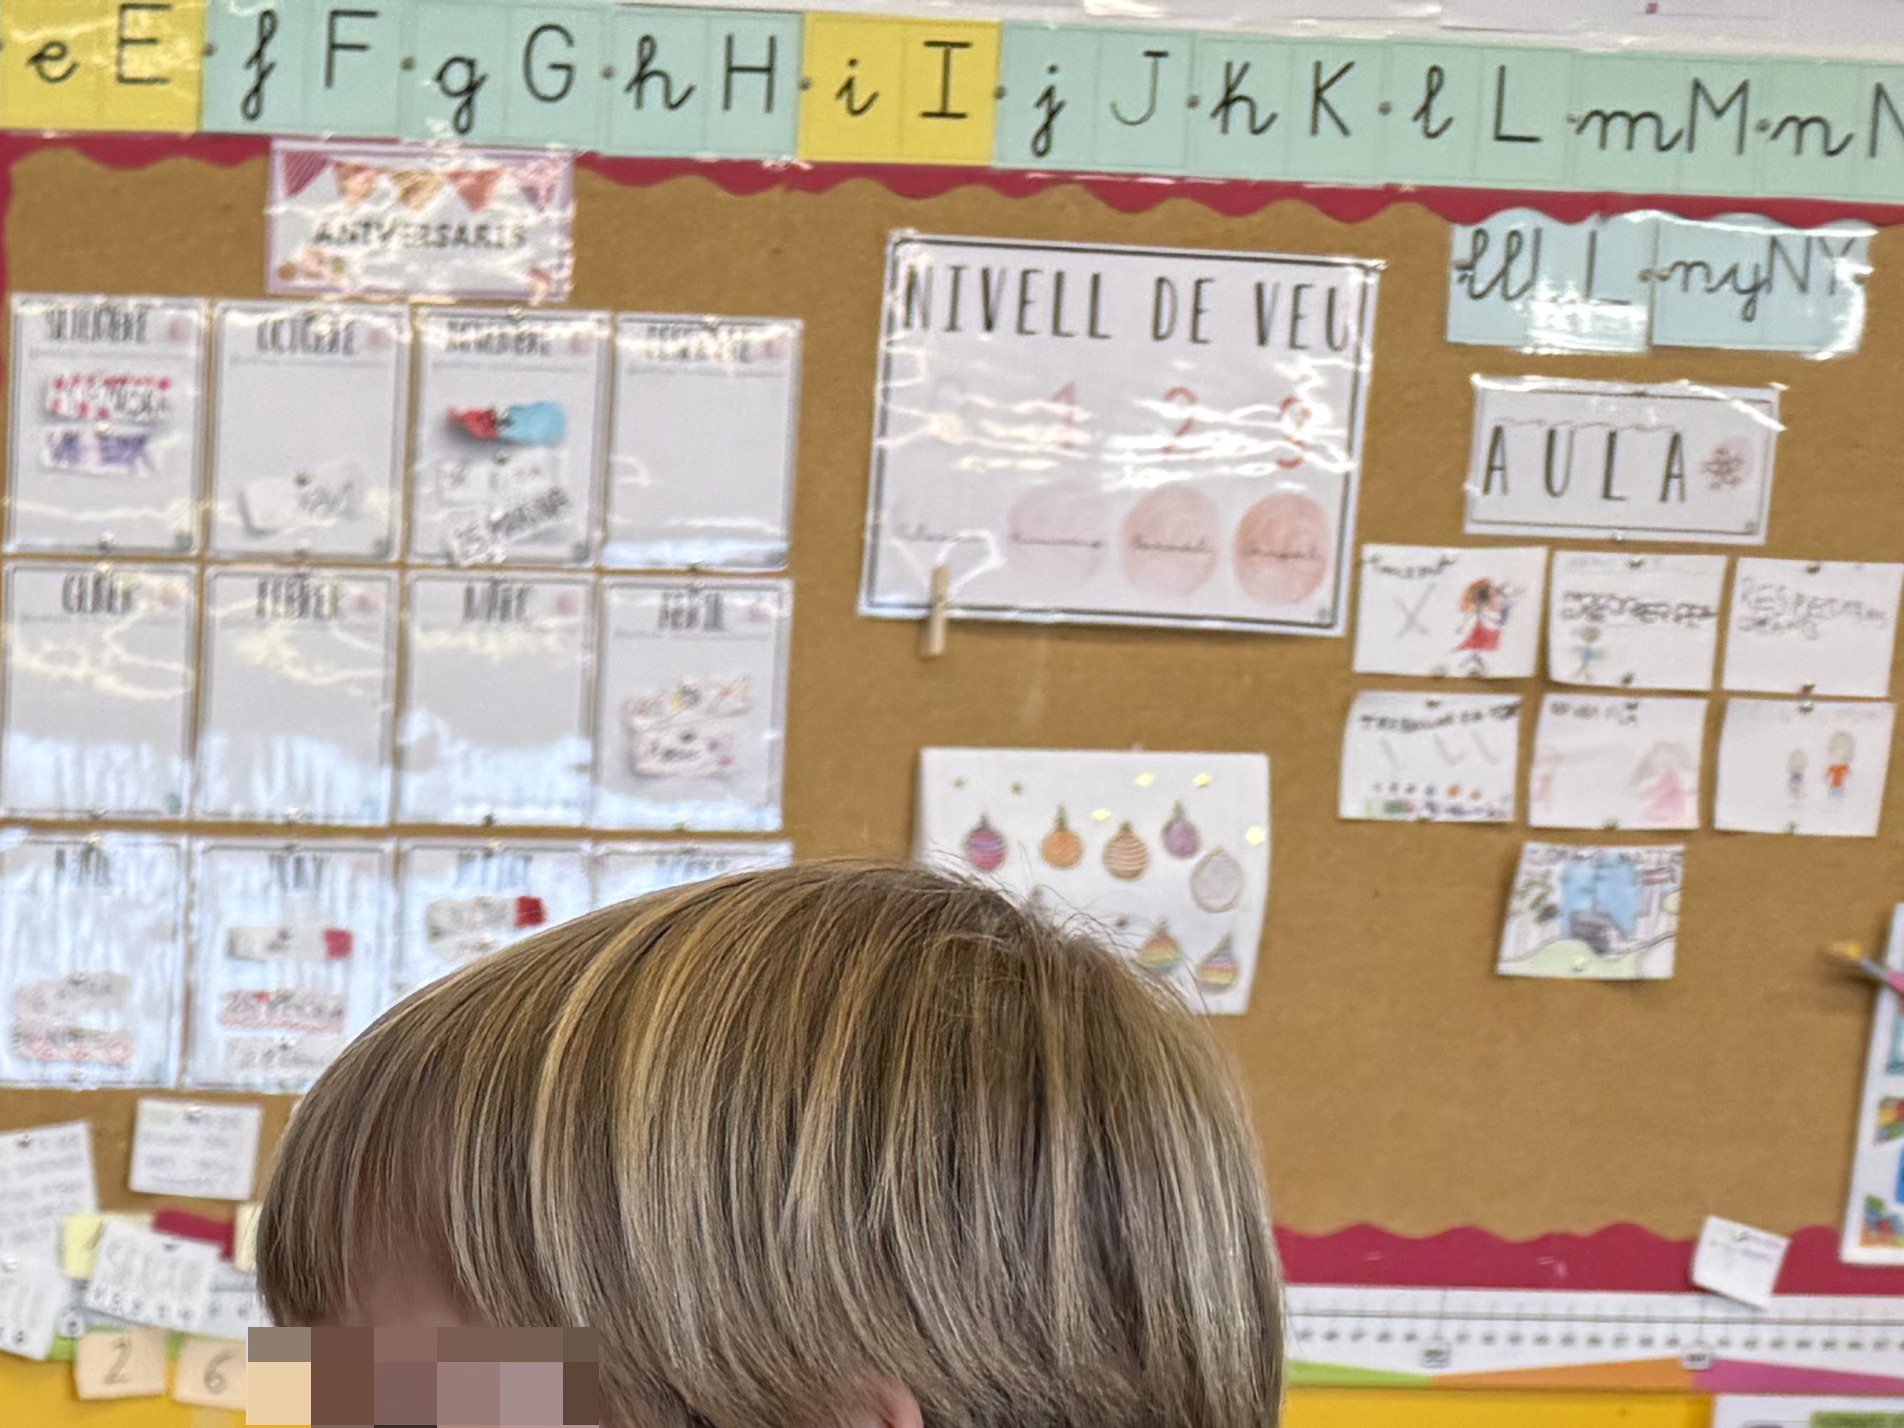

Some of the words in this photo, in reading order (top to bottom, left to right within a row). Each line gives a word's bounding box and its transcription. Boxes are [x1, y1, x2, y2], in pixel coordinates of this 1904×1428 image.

[26, 40, 80, 84] e
[116, 2, 172, 86] E
[240, 9, 279, 122] f
[324, 8, 379, 89] F
[433, 55, 488, 137] g
[522, 23, 576, 104] G
[624, 33, 696, 112] h
[722, 33, 777, 114] H
[835, 57, 880, 117] i
[919, 39, 975, 120] I
[1028, 64, 1068, 159] j
[1110, 49, 1170, 127] J
[1310, 60, 1356, 137] K
[1412, 64, 1454, 140] l
[1493, 64, 1542, 144] L
[1578, 109, 1684, 153] m
[1687, 77, 1750, 155] M
[1782, 115, 1854, 158] n
[900, 262, 1112, 342] NIVELL
[1151, 276, 1217, 345] DE
[1255, 281, 1352, 353] VEU
[1481, 425, 1687, 504] AULA
[204, 1349, 233, 1395] 6
